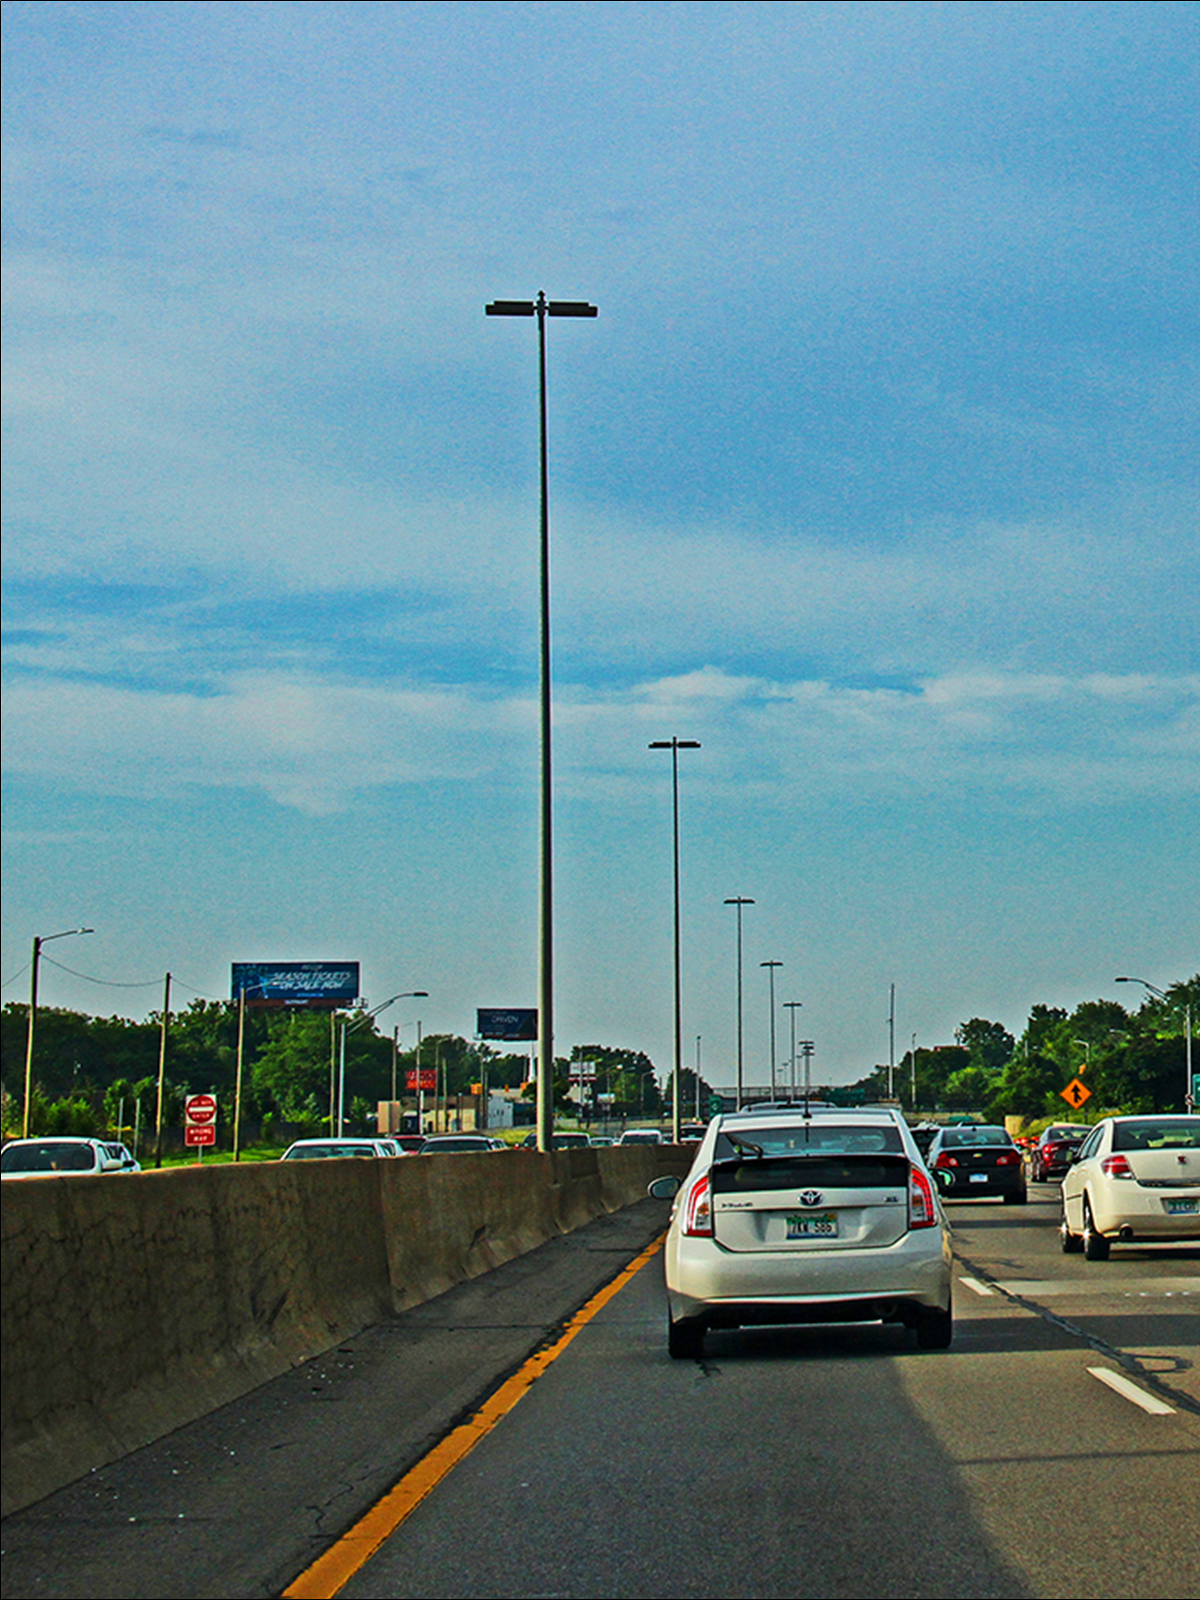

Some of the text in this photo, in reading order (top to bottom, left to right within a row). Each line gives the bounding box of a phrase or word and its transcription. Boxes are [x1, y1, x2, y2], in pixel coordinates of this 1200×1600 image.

[273, 970, 351, 981] SEASON TICKETS
[280, 980, 345, 991] ON SALE NOW
